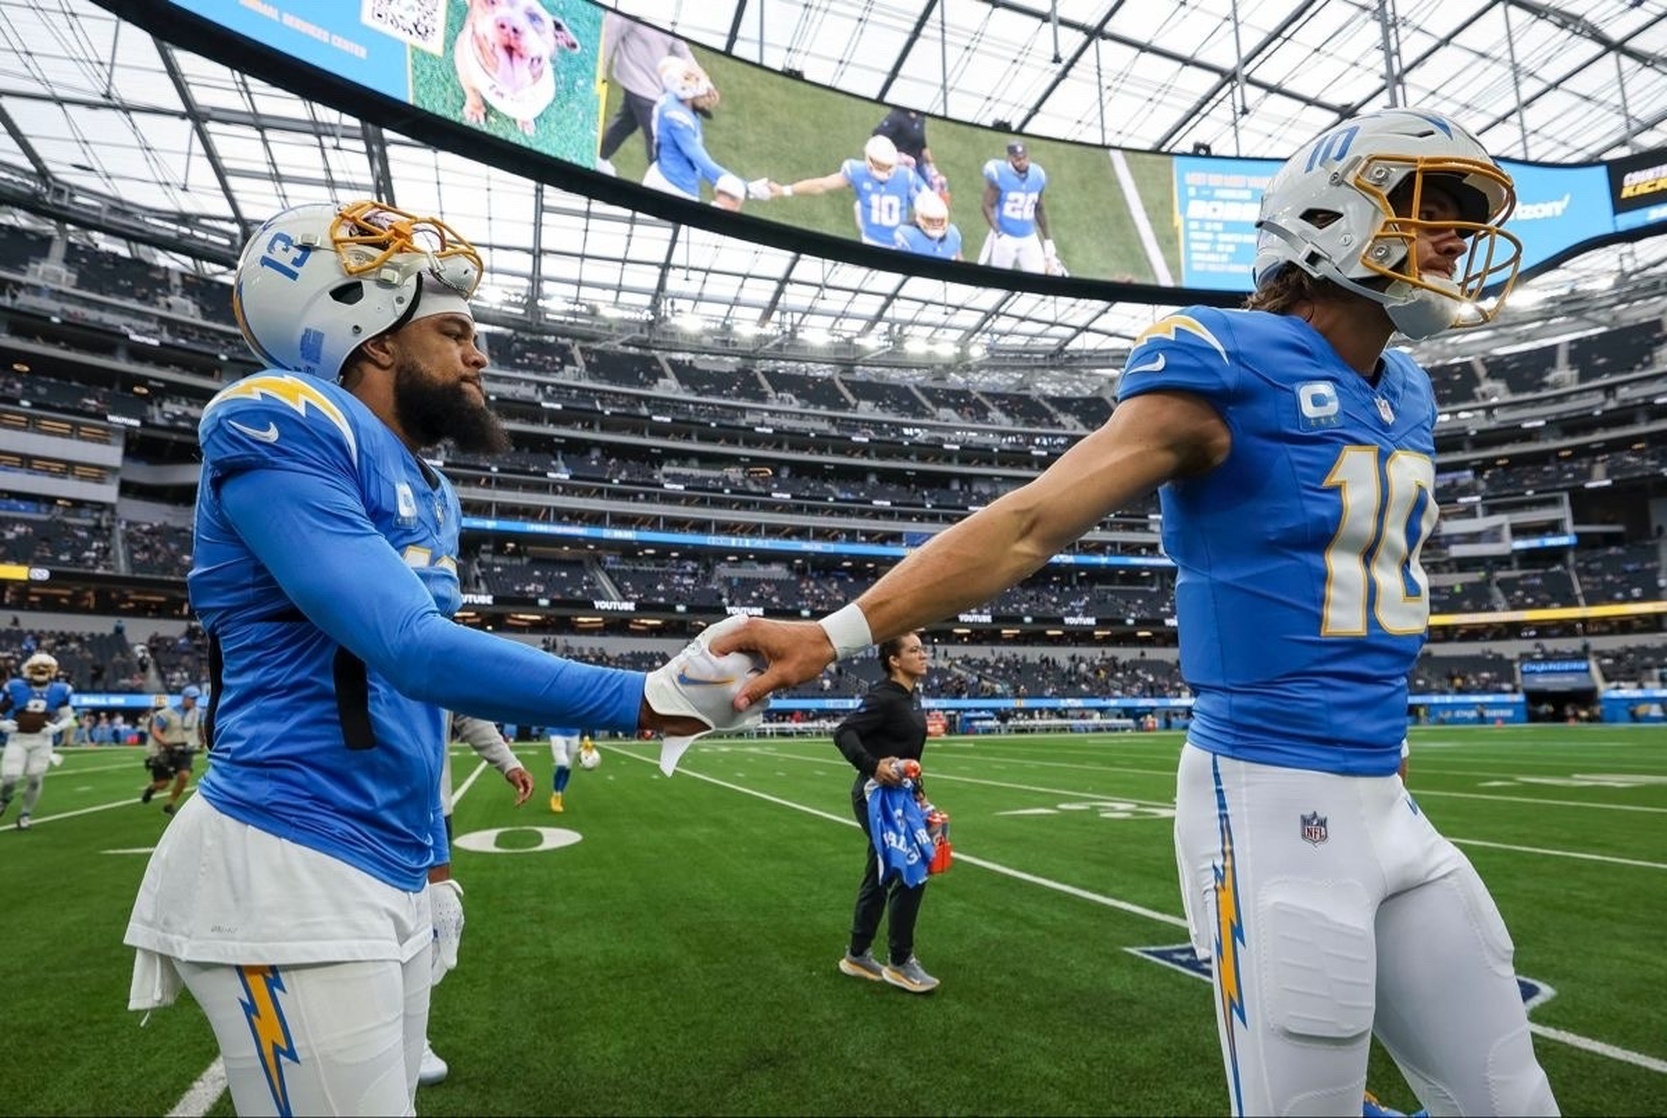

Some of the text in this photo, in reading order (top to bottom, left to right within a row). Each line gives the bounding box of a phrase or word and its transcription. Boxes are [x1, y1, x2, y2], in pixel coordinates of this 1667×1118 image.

[1303, 125, 1360, 174] 10
[869, 193, 900, 227] 10
[260, 231, 311, 281] 13
[1299, 383, 1339, 418] C
[1320, 445, 1438, 638] 10
[593, 600, 636, 616] YOUTUBE
[725, 606, 764, 616] YOUTUBE
[957, 614, 992, 624] YOUTUBE
[1063, 616, 1097, 626] YOUTUBE
[1304, 826, 1327, 841] NFL
